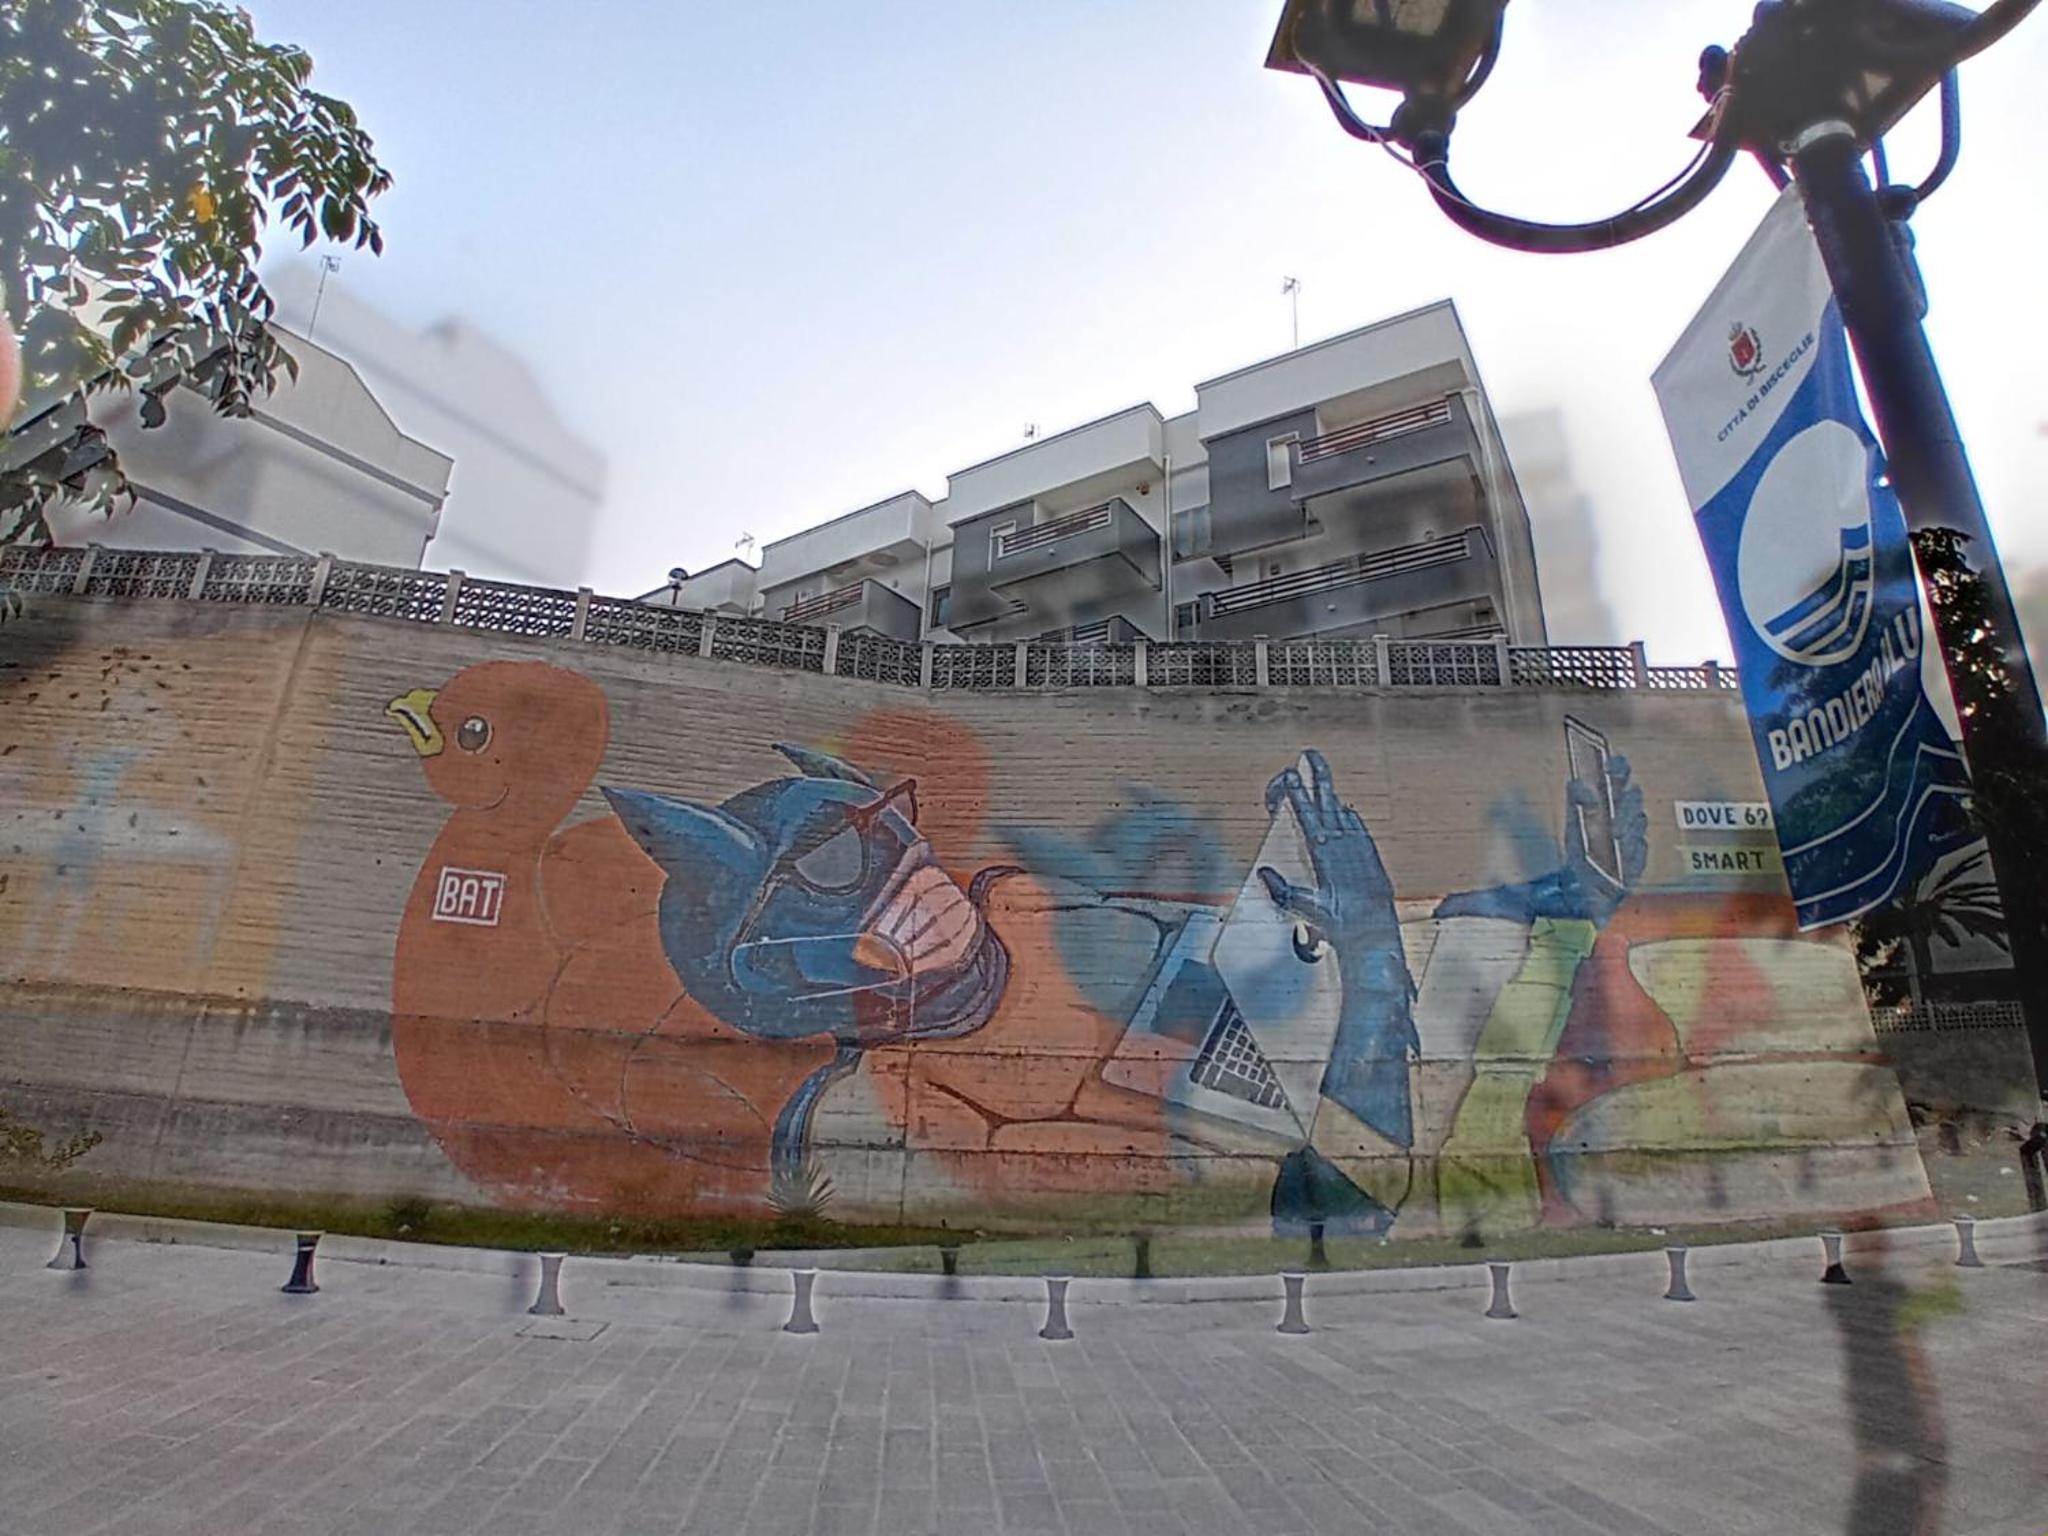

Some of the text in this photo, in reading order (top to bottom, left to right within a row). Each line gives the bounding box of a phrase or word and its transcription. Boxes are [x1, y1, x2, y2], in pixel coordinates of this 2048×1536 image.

[1747, 395, 1760, 410] DI
[1759, 331, 1814, 397] BISCEGLIE
[1768, 657, 1885, 772] BANDIERA
[1683, 807, 1736, 825] DOVE
[1692, 851, 1764, 870] SMART
[440, 876, 499, 917] BAT
